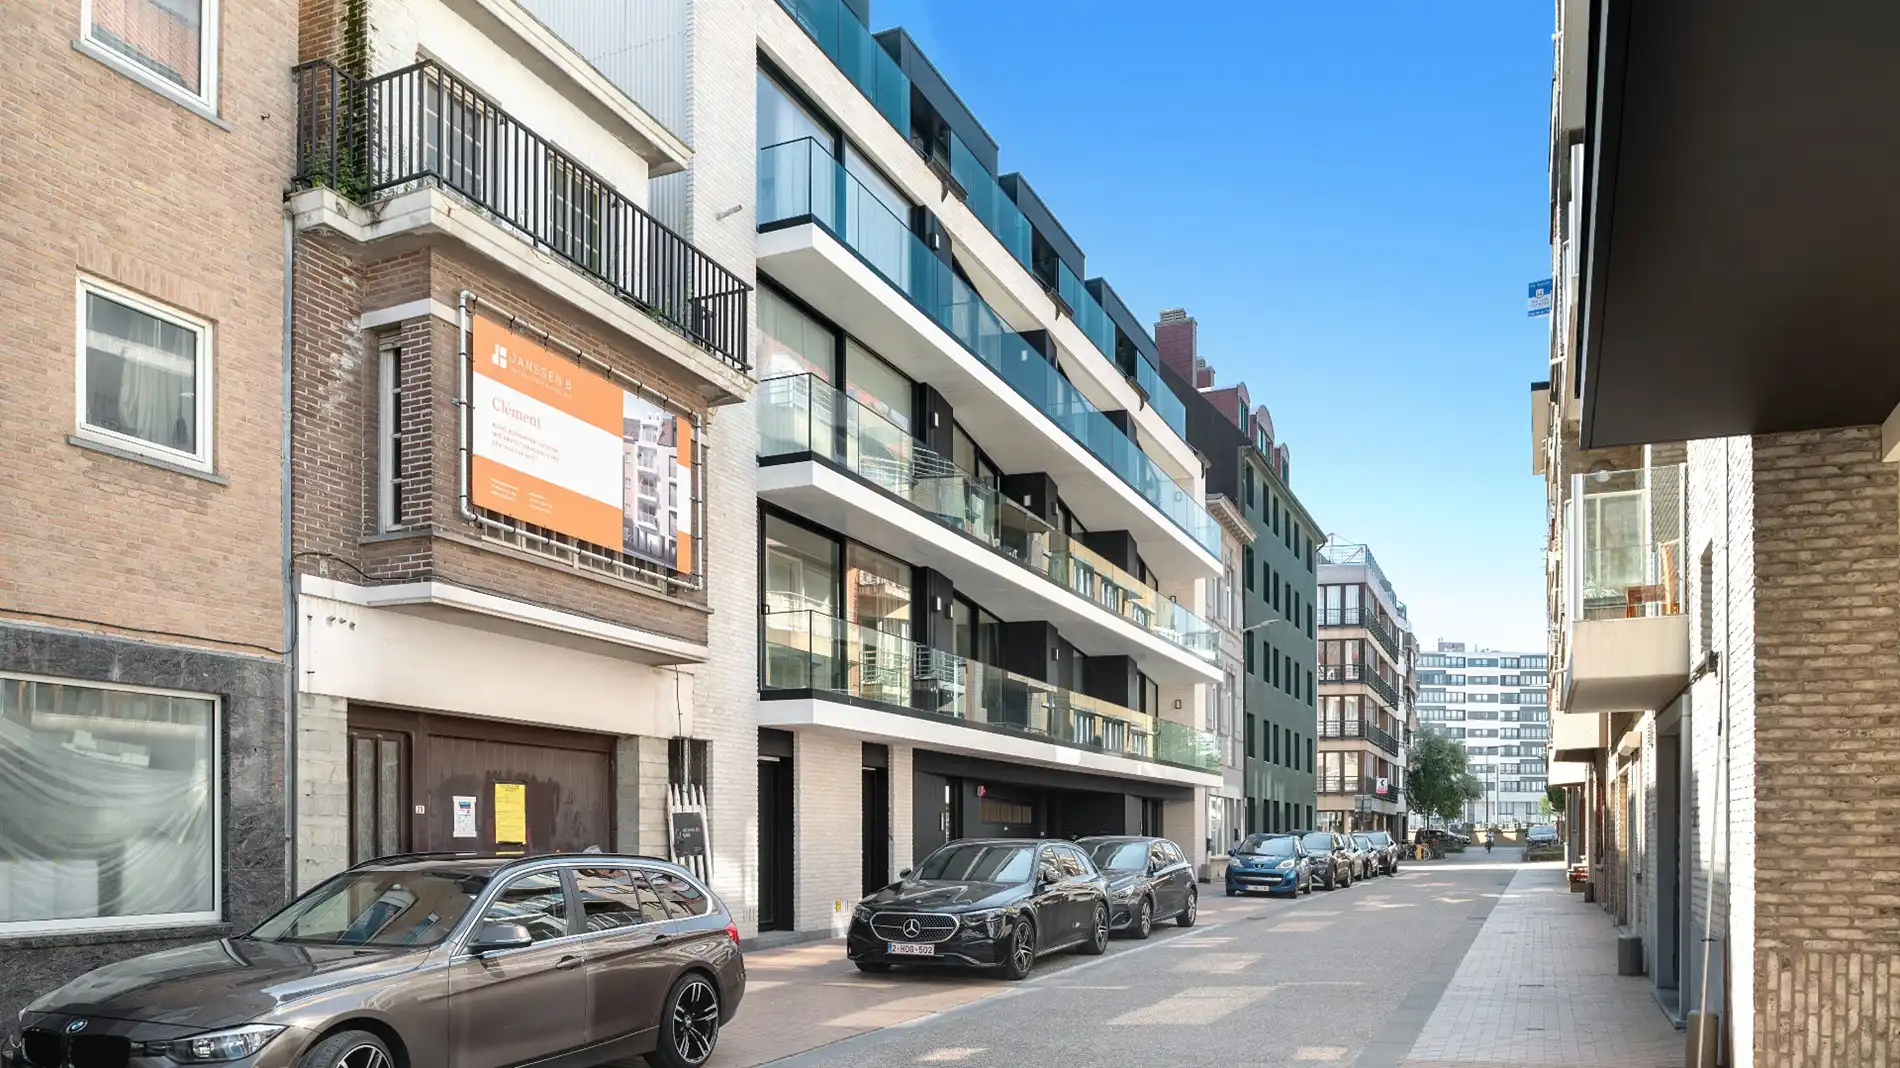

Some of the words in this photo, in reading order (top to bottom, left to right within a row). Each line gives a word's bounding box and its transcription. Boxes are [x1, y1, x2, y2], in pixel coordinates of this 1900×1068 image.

[509, 352, 562, 387] JANSSEN
[565, 375, 572, 390] B
[492, 397, 541, 429] Clément
[892, 944, 933, 954] 2-HDG-502
